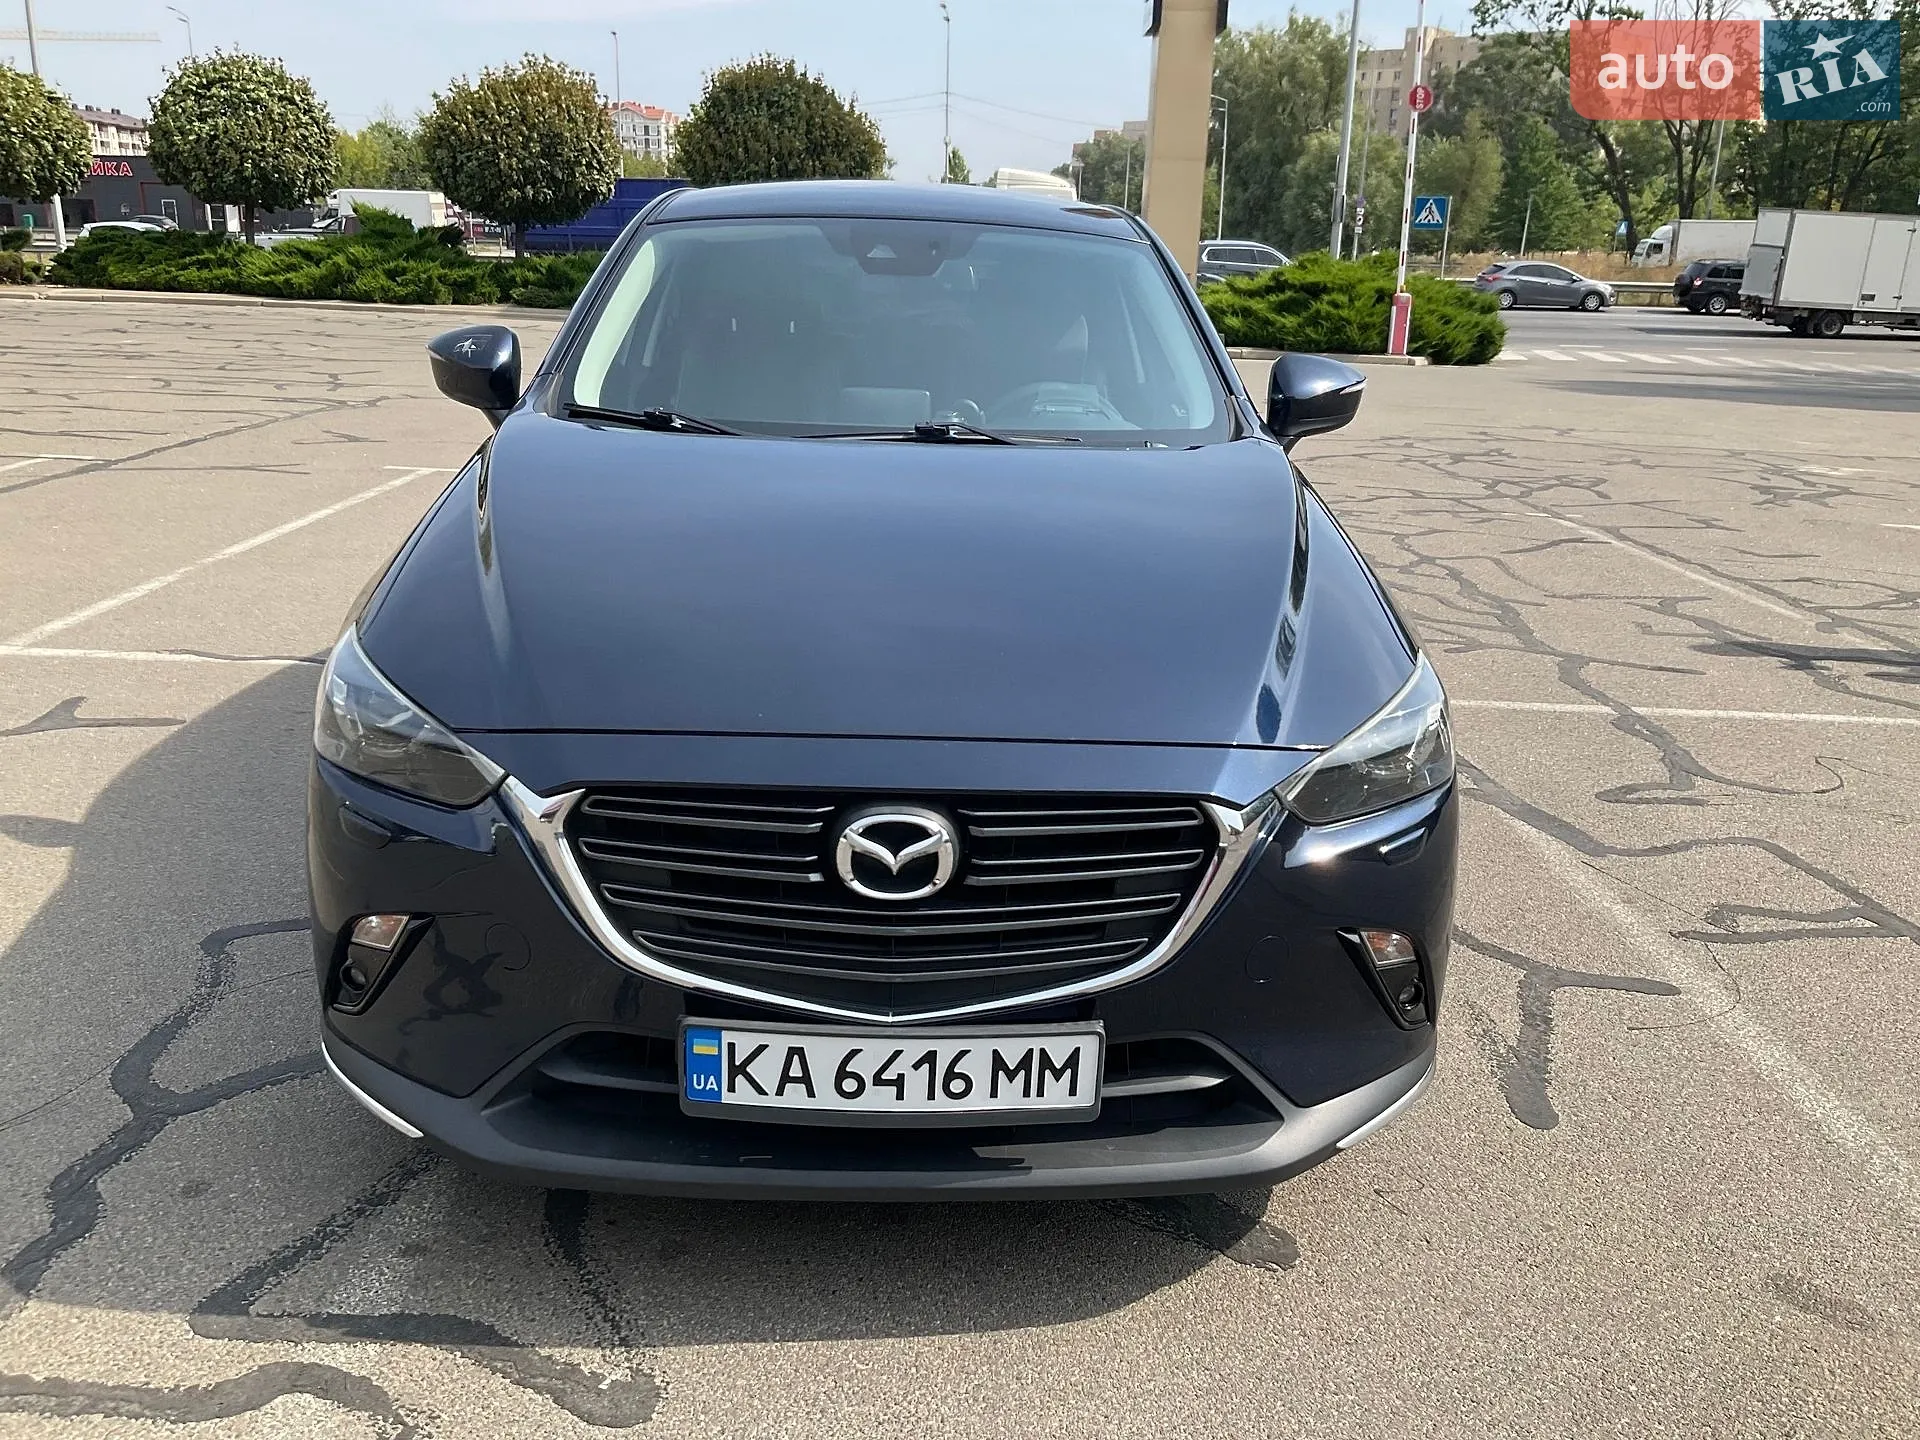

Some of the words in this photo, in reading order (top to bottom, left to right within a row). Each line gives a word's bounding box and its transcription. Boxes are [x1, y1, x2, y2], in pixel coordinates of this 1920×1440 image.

[1416, 87, 1425, 109] STOP
[87, 158, 133, 176] ЙКА
[726, 1041, 816, 1098] KA
[834, 1048, 974, 1101] 6416
[989, 1046, 1081, 1099] MM
[692, 1073, 719, 1091] UA
